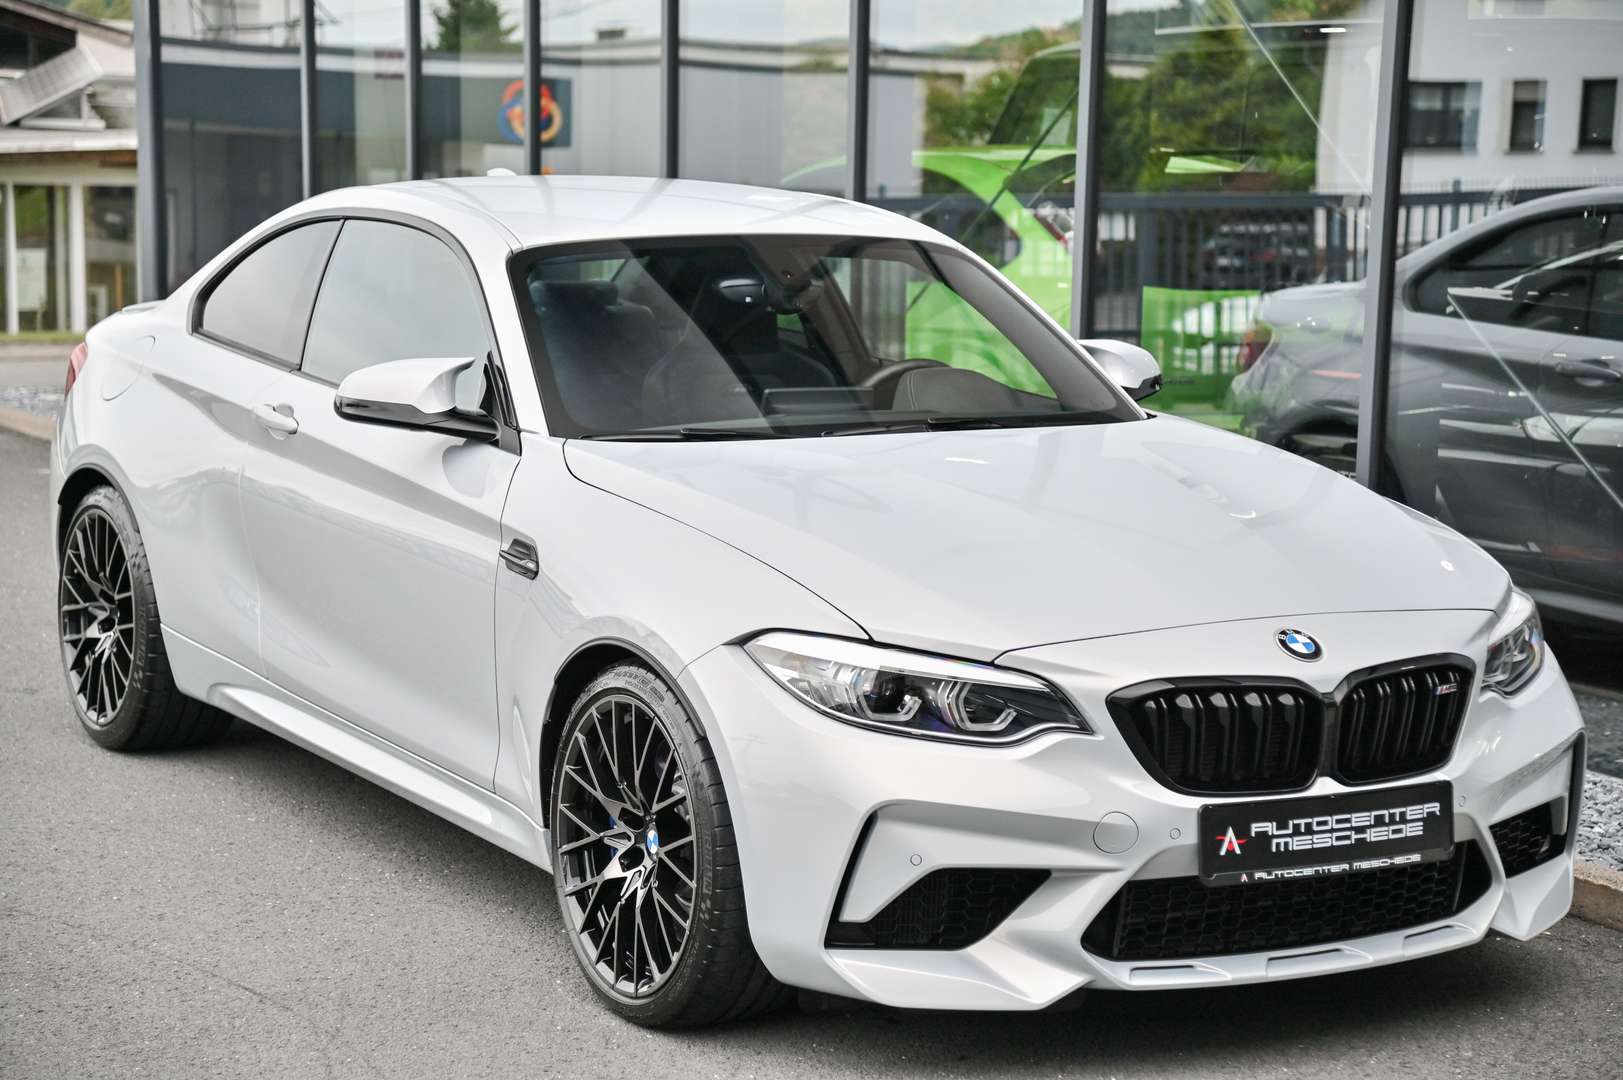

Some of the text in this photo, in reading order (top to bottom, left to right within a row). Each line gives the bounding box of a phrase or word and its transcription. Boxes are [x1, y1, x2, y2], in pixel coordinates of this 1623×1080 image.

[1250, 802, 1441, 837] AUTOCENTER
[1271, 821, 1424, 853] MESCHEDE
[1254, 863, 1350, 880] AUTOCENTER
[1353, 853, 1422, 871] MESCHEDE
